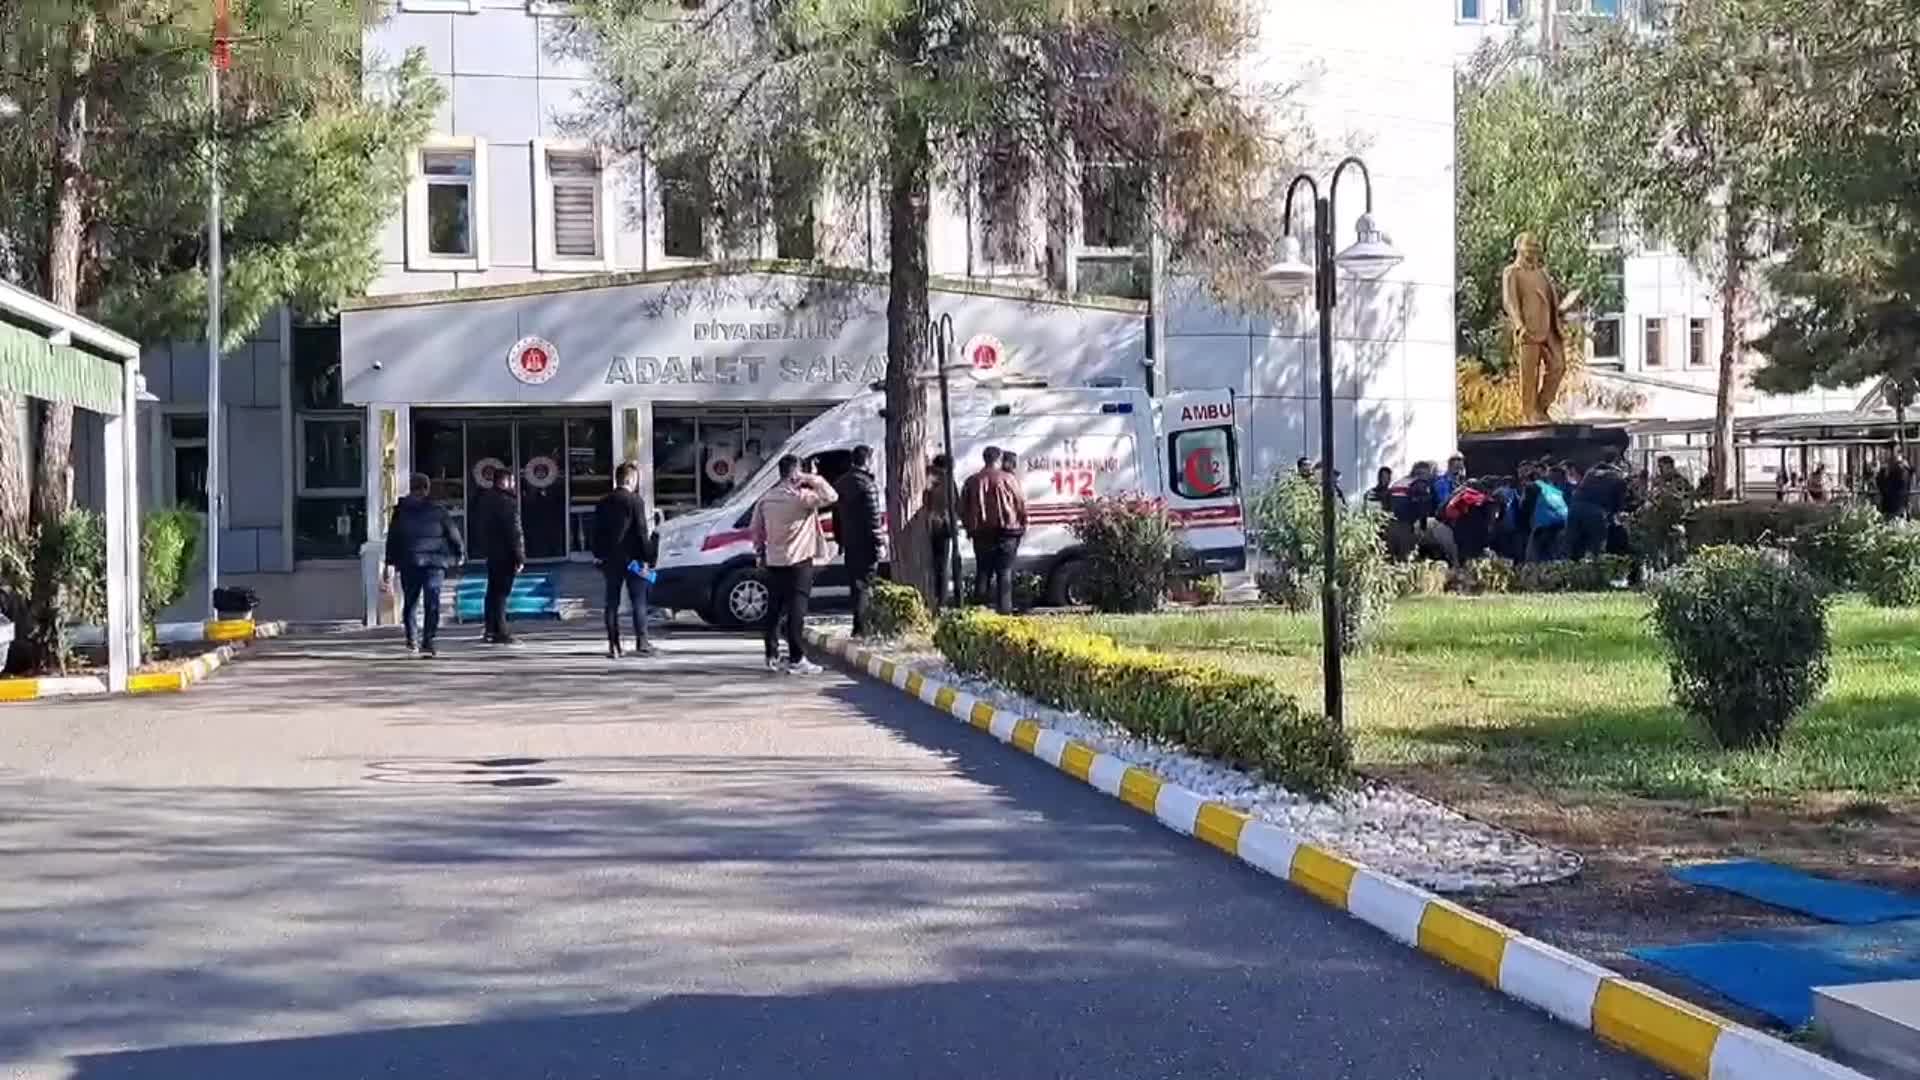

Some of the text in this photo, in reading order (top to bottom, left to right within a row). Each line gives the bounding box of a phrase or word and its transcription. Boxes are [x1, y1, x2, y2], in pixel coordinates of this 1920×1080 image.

[605, 356, 766, 384] ADALET
[1181, 403, 1231, 421] AMBU
[1051, 472, 1093, 496] 112
